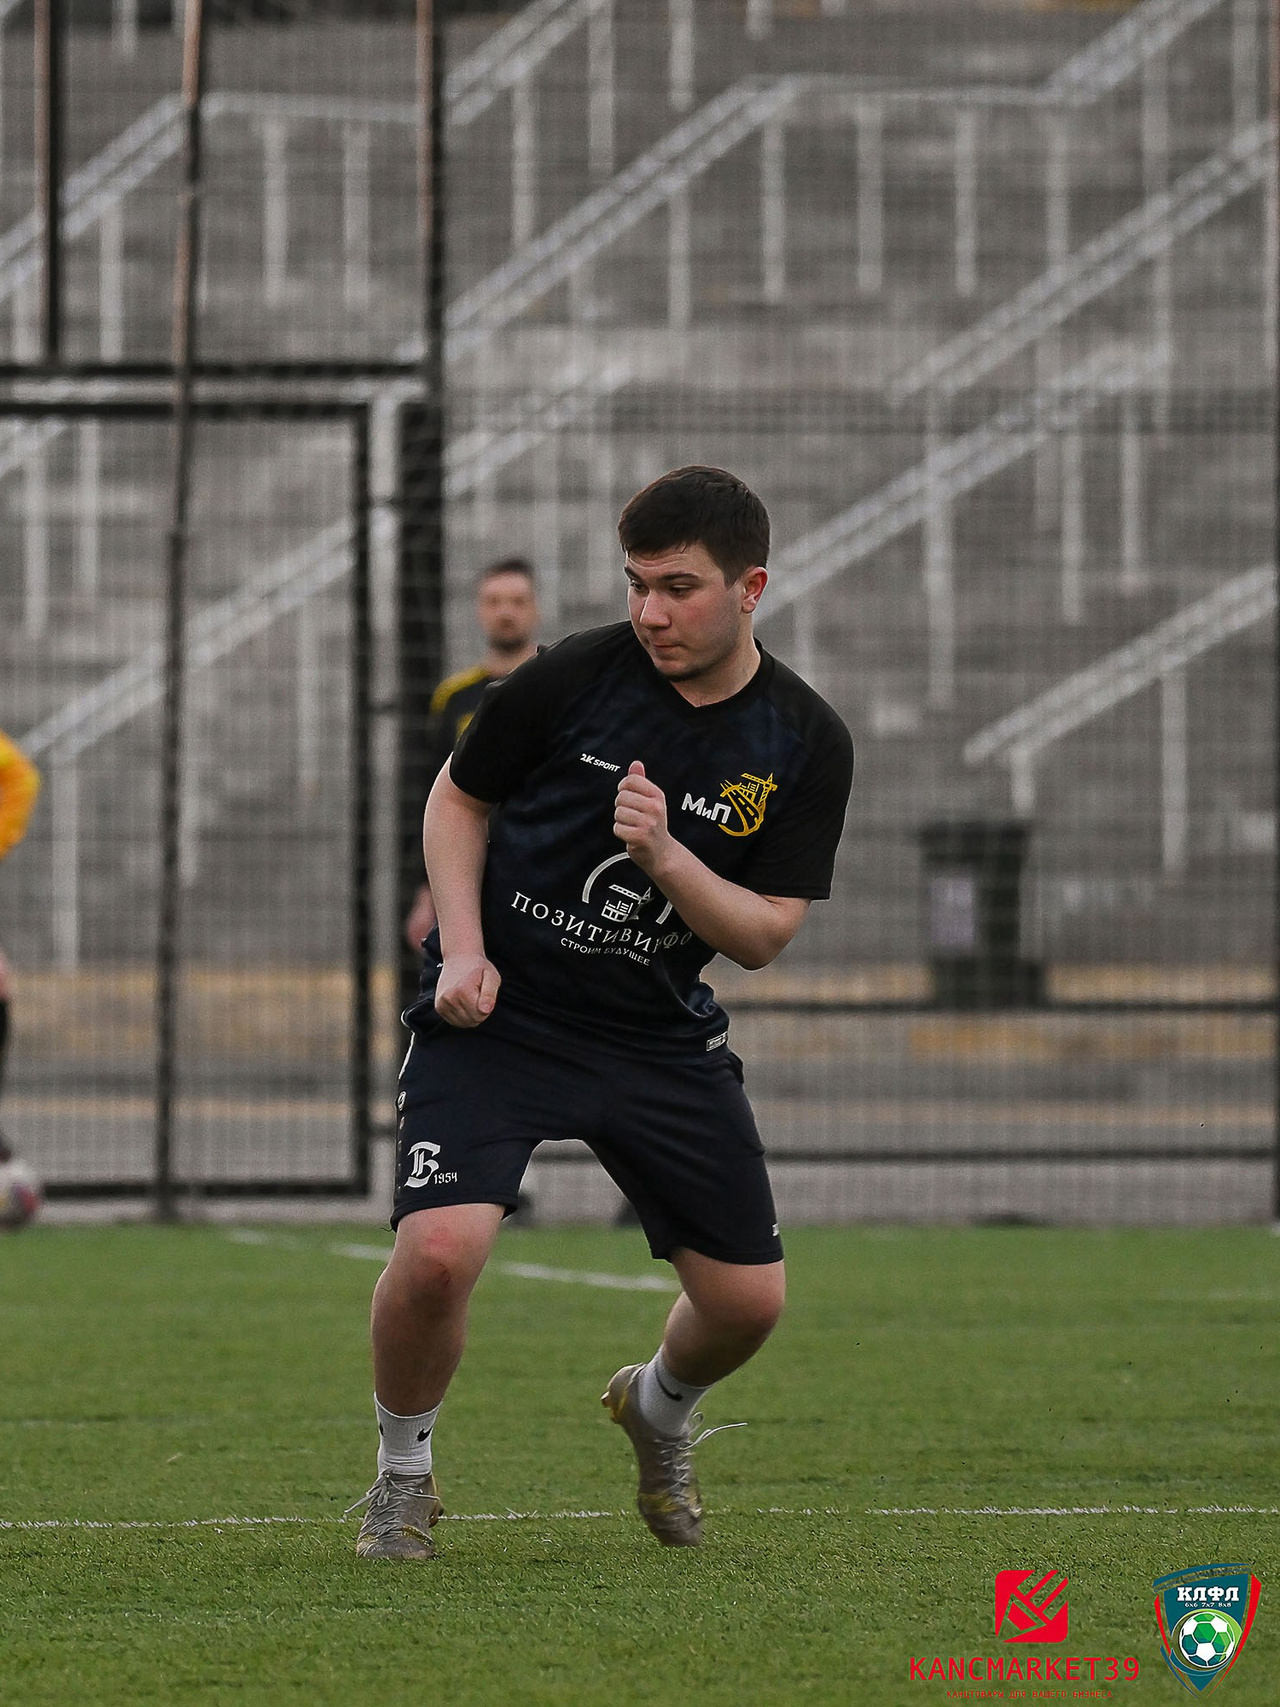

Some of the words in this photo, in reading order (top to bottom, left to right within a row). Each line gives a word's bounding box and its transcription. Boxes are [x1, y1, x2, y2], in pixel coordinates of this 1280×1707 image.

[593, 759, 621, 772] SPORT
[681, 792, 731, 824] МиП
[433, 1172, 458, 1185] 1954
